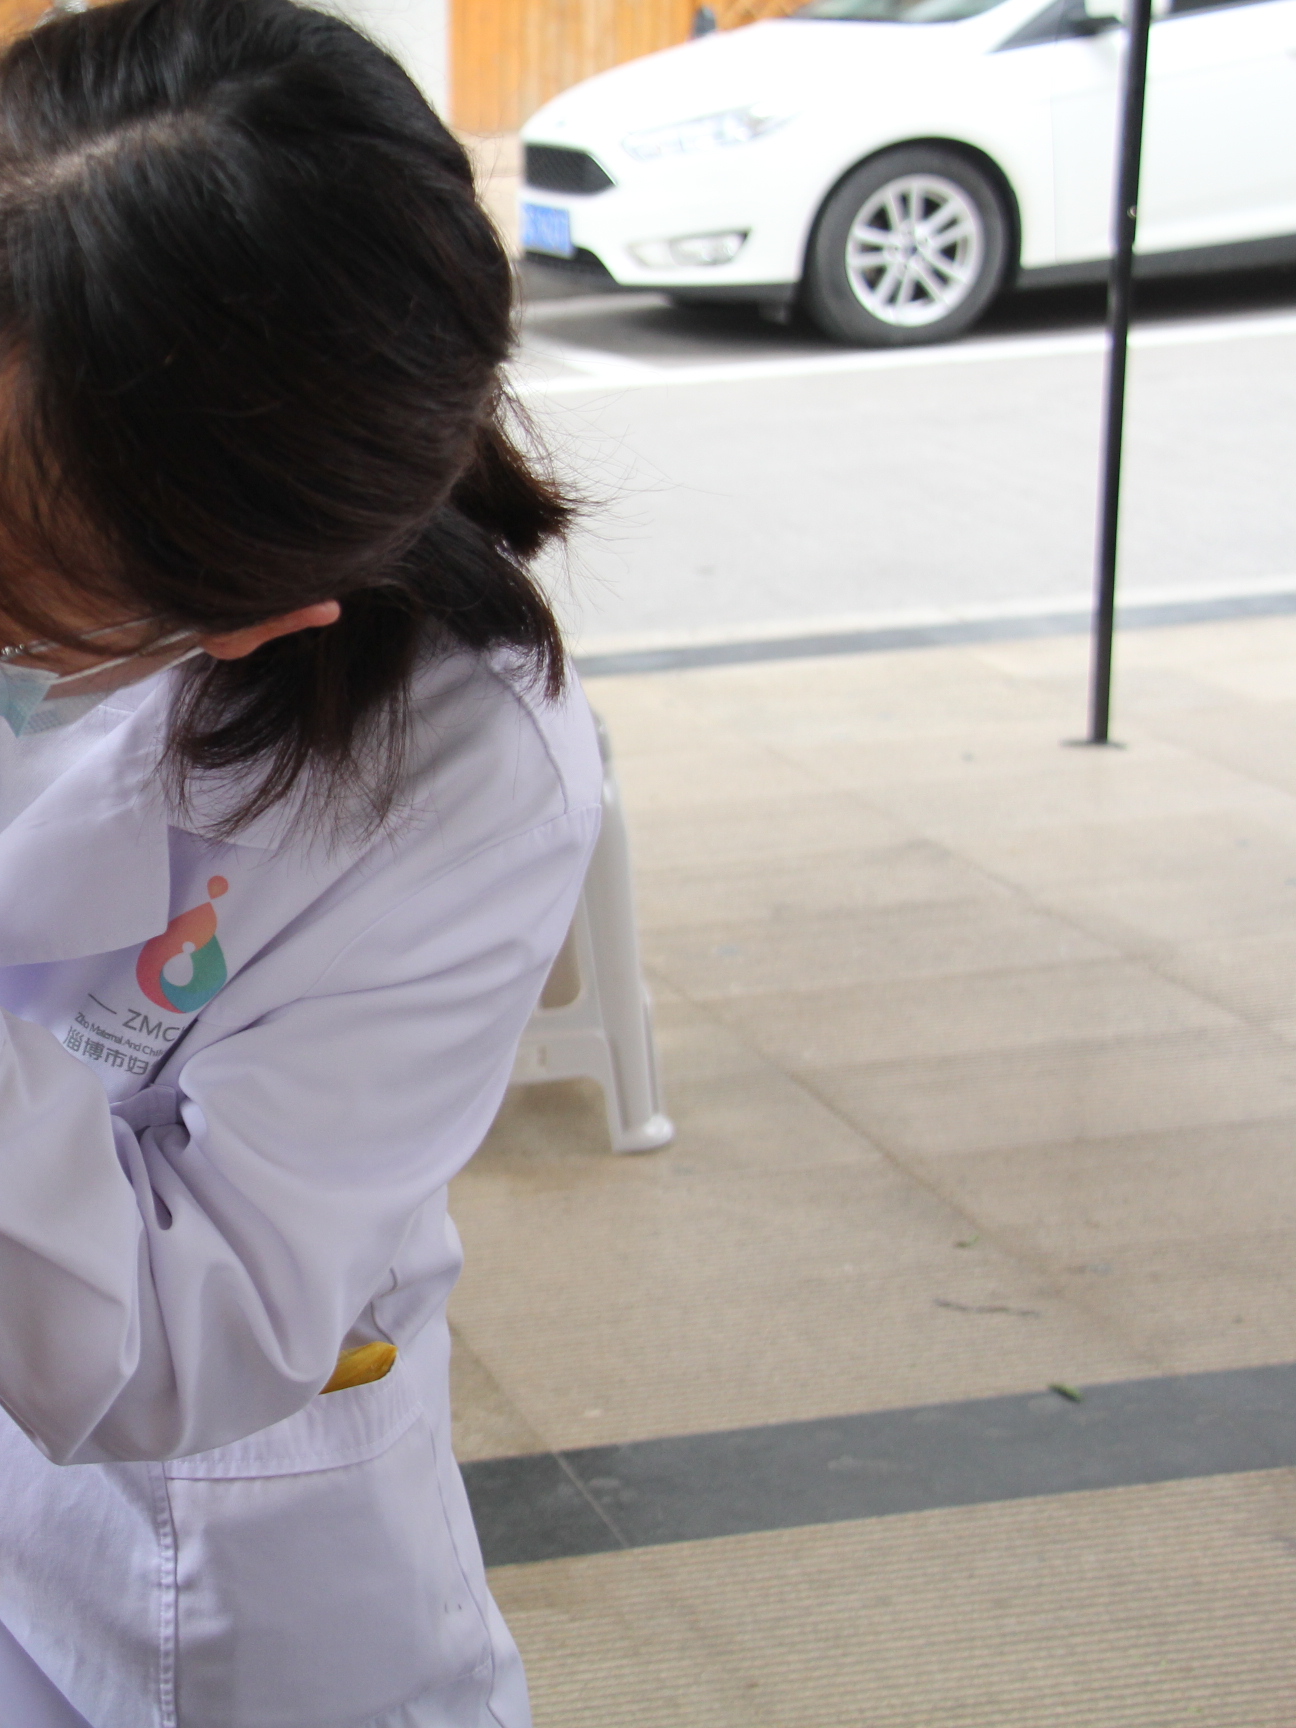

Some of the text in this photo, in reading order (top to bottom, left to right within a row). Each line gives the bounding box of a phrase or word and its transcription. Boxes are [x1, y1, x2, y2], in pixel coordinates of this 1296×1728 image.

[122, 1008, 186, 1042] ZMC
[63, 1025, 149, 1075] 淄博市妇
[123, 1039, 141, 1052] And
